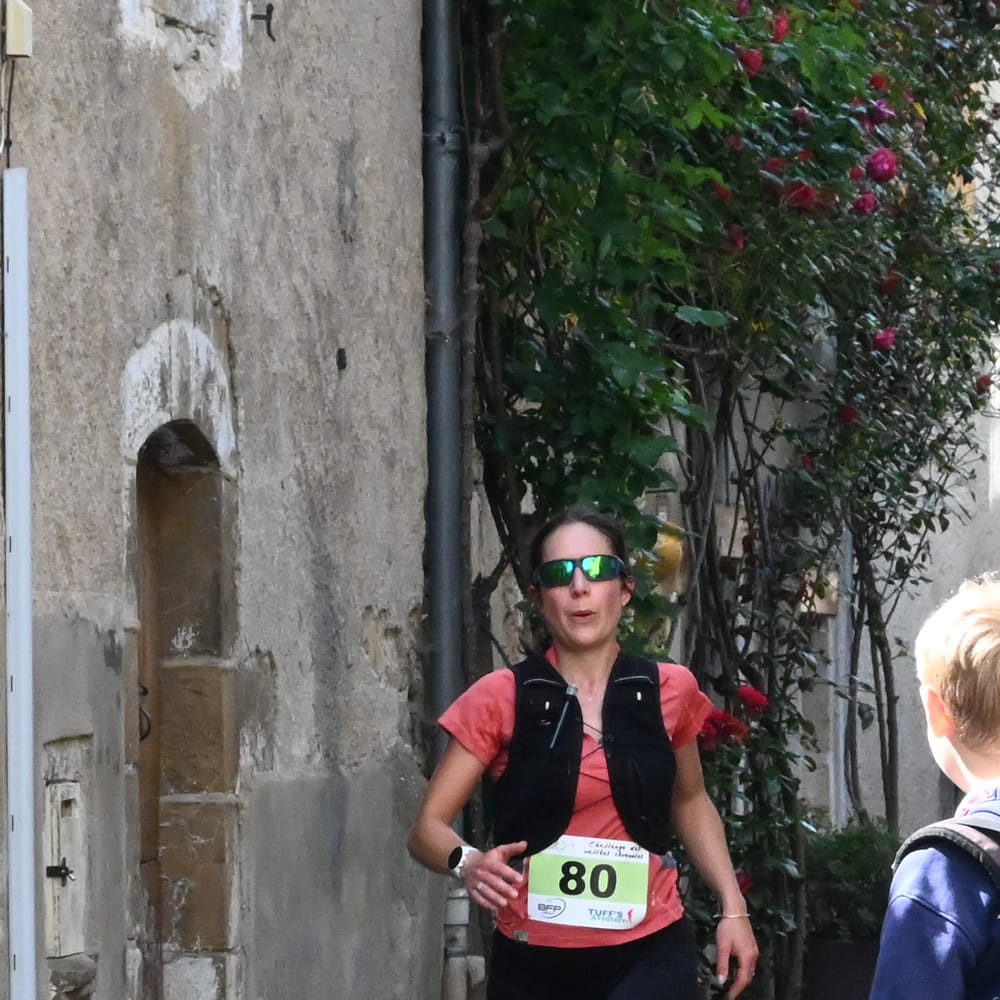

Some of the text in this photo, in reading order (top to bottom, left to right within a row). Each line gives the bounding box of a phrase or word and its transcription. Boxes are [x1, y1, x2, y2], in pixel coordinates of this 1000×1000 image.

[558, 860, 617, 898] 80
[537, 903, 562, 912] BFP
[588, 908, 623, 918] TUFF'S
